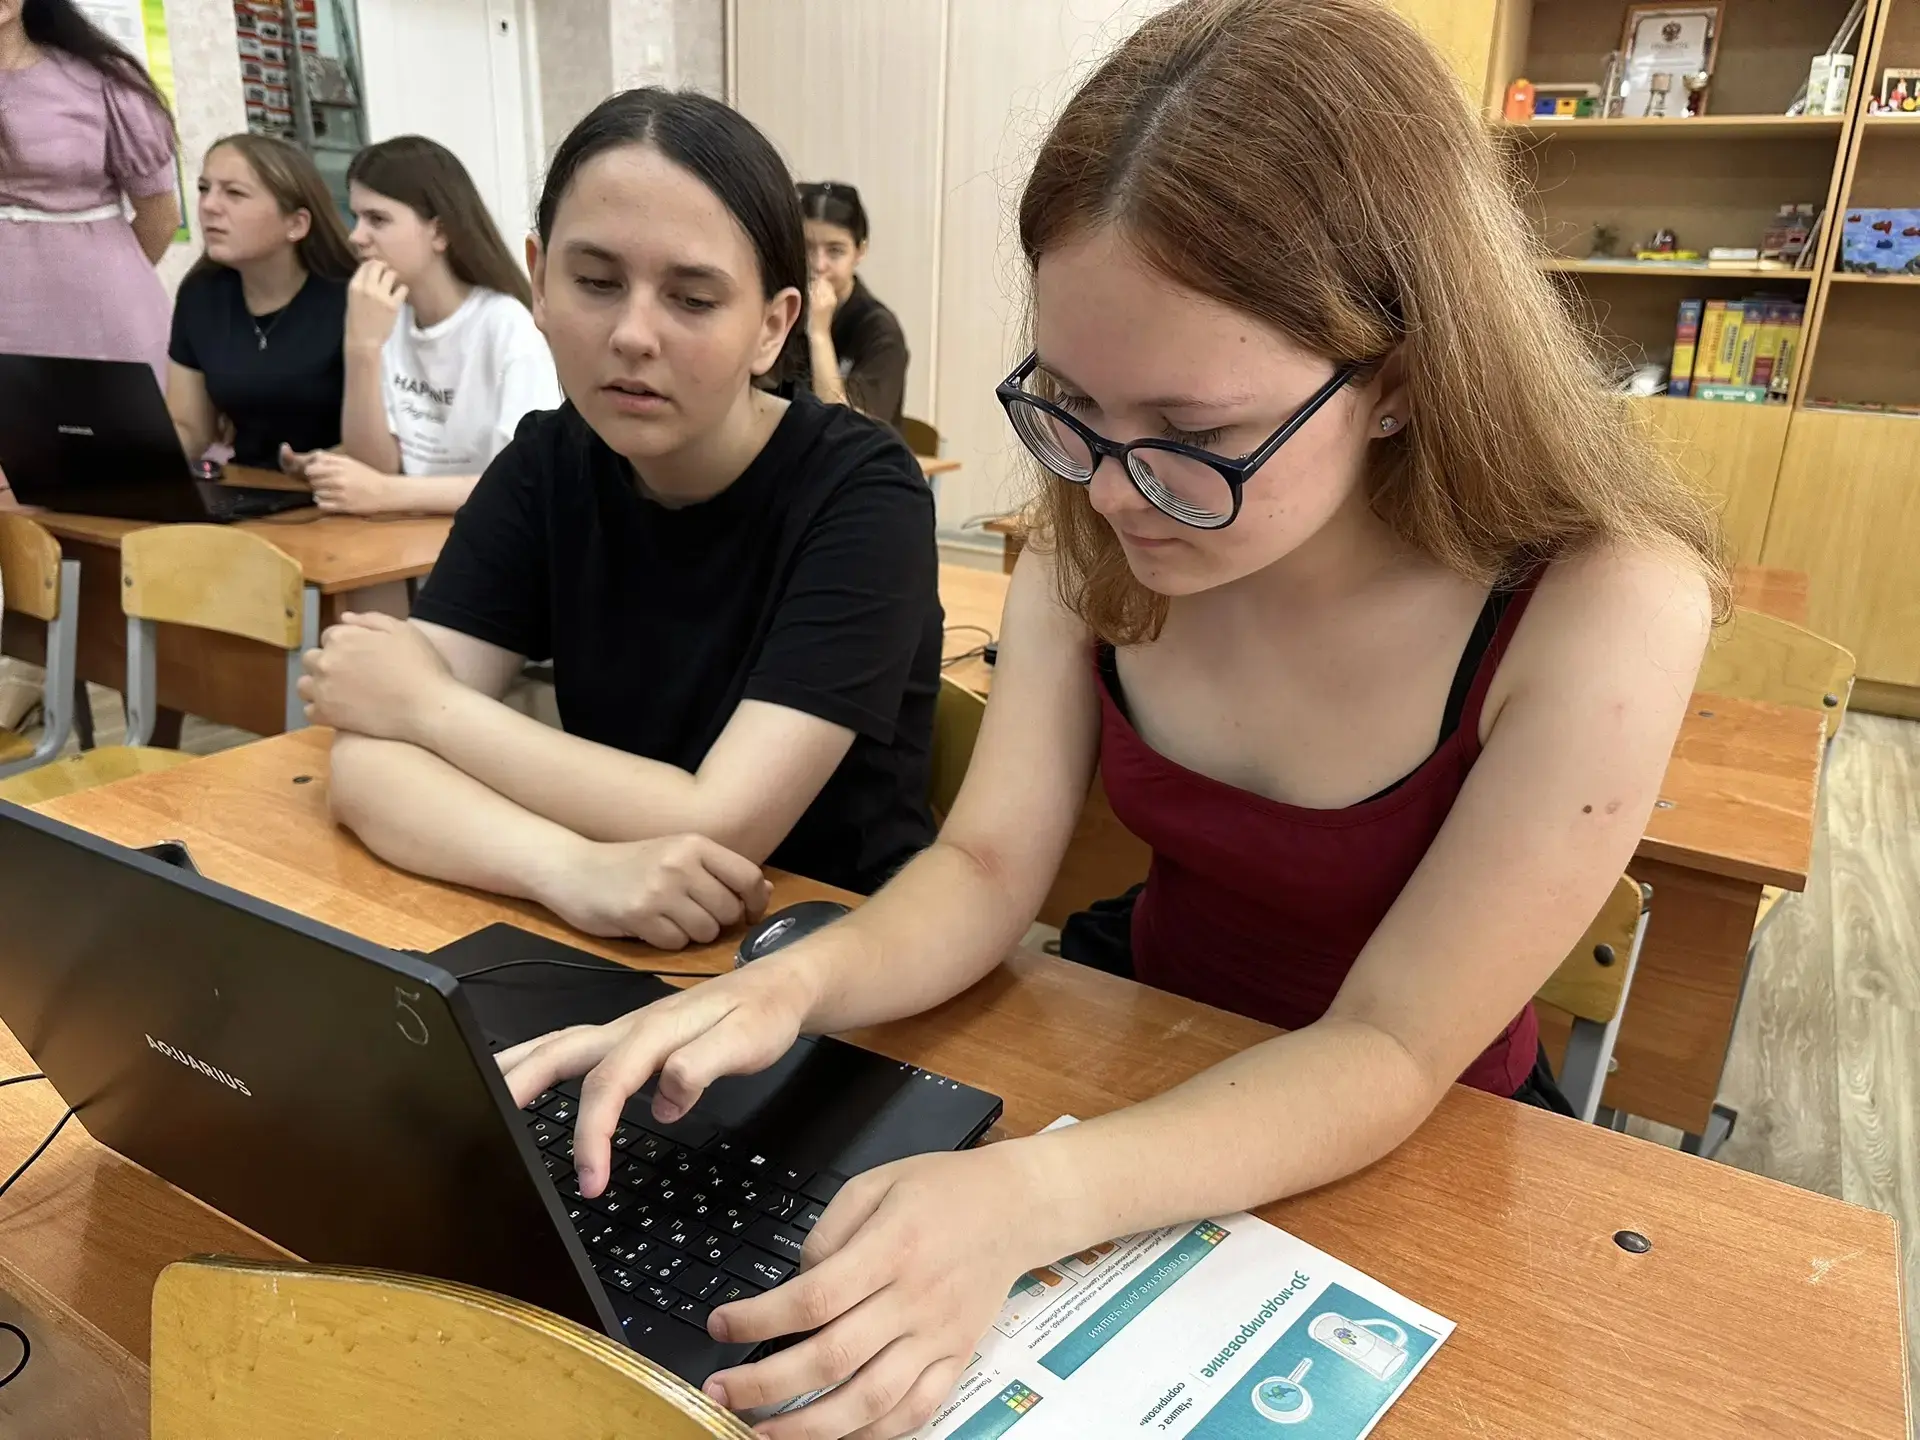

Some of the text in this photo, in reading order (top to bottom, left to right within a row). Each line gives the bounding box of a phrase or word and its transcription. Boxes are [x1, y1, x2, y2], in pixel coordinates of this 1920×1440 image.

[145, 1033, 252, 1097] AQUARIUS
[1088, 1252, 1190, 1339] Отверстие для чашки
[1200, 1270, 1310, 1378] 3D-моделирование
[961, 1377, 993, 1403] Поместите
[1000, 1384, 1021, 1402] CAD
[1139, 1381, 1186, 1427] сюрпризом»
[931, 1401, 962, 1427] отверстие
[1157, 1397, 1193, 1431] «Чашка с
